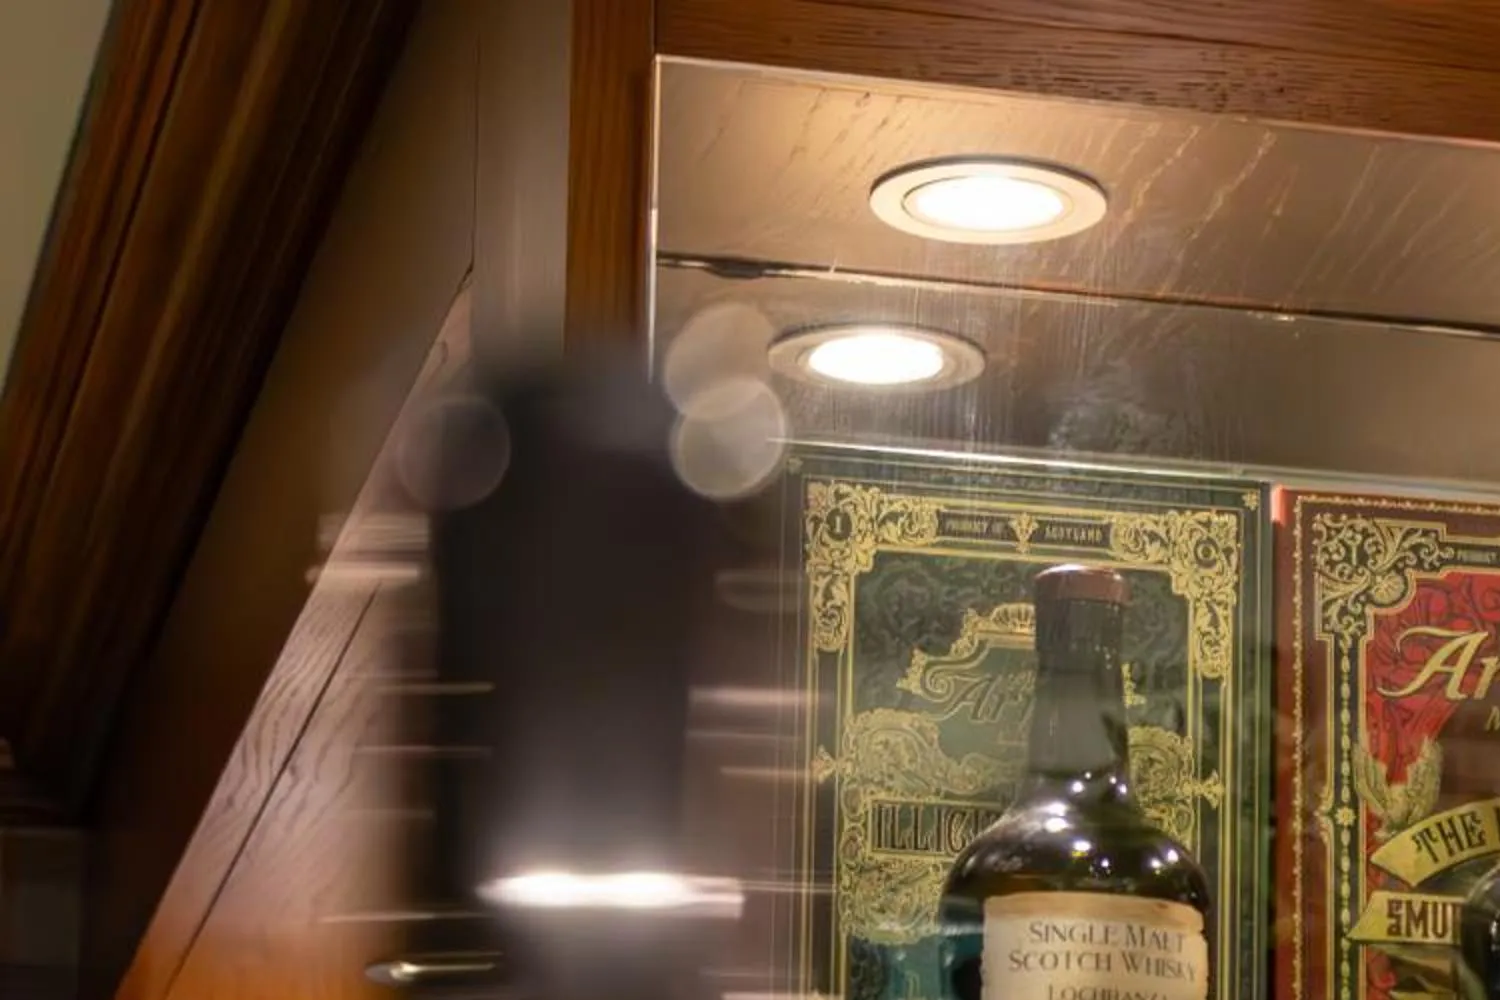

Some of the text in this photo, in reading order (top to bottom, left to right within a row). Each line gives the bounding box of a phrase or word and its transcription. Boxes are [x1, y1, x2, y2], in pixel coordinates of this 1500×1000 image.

[1411, 810, 1489, 865] THE
[1028, 920, 1188, 952] SINGLE MALT
[1008, 949, 1113, 974] SCOTCH
